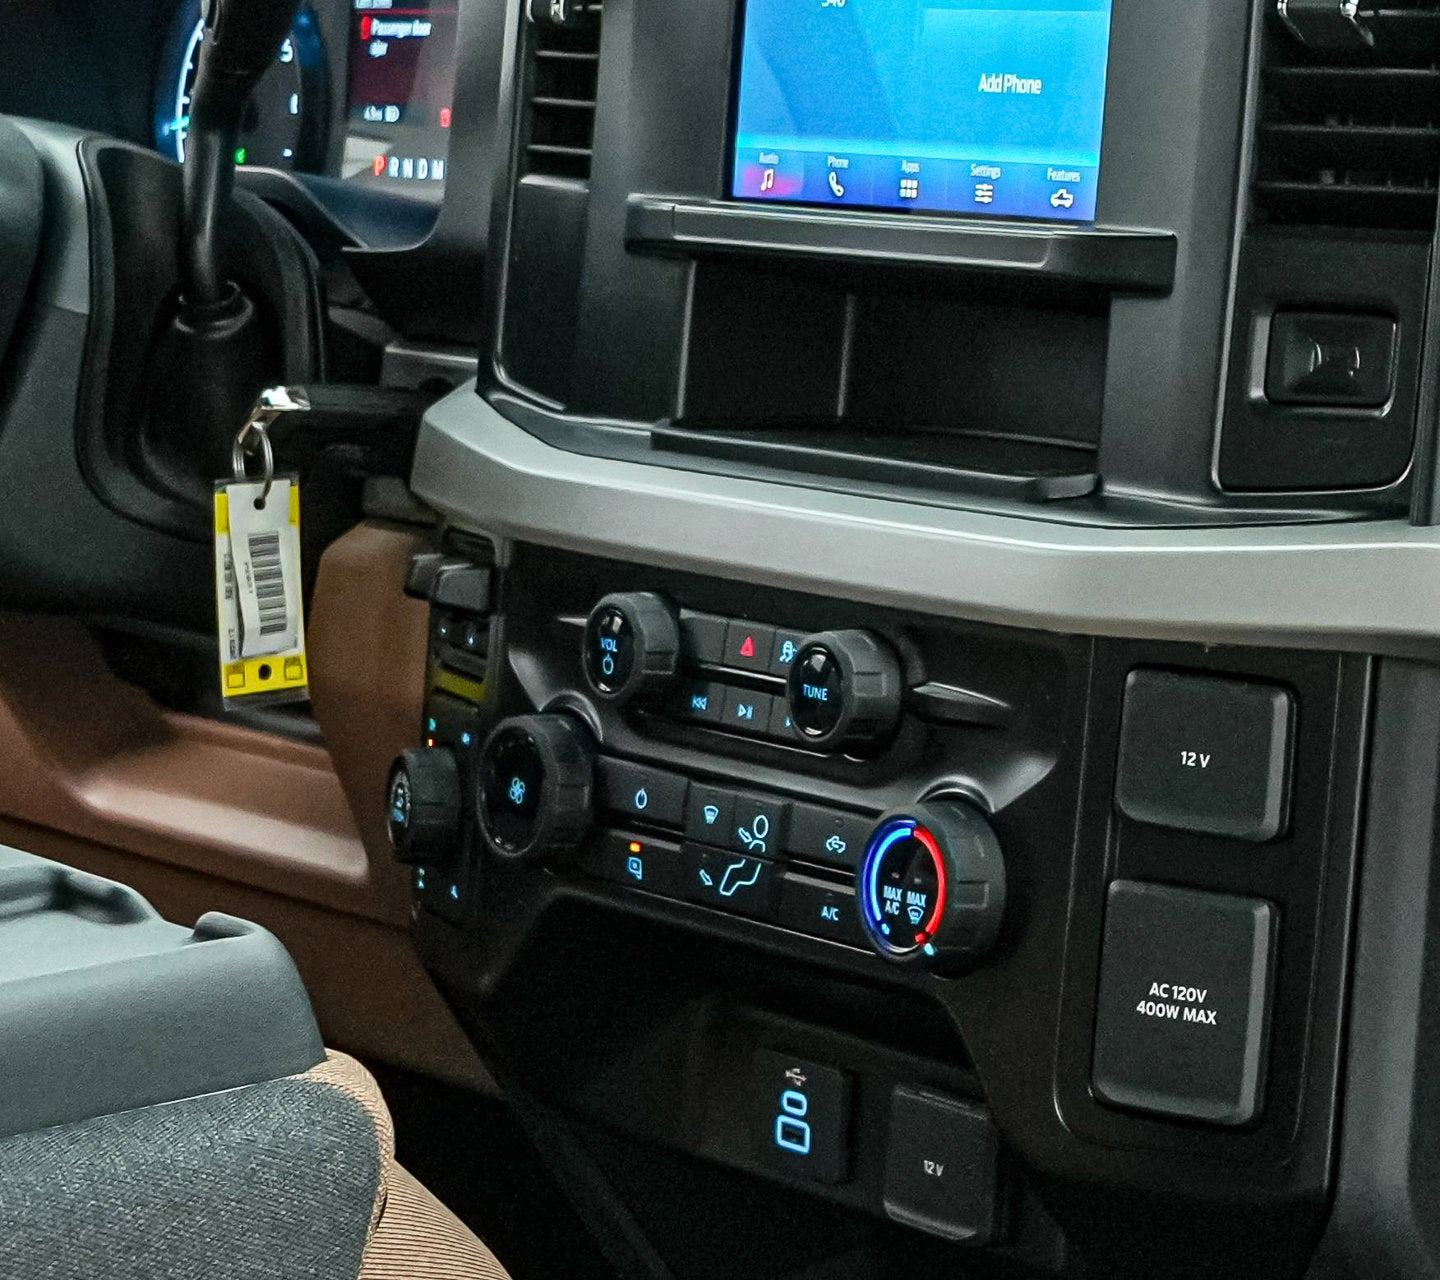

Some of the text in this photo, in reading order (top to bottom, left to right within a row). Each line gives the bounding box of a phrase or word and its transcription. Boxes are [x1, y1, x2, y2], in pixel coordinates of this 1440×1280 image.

[978, 73, 1042, 95] Add Phone
[373, 155, 387, 176] P
[389, 156, 400, 178] R
[402, 158, 413, 179] N
[417, 158, 428, 180] D
[827, 156, 849, 169] Phone
[901, 159, 920, 173] Apps
[970, 163, 1001, 180] Settings
[1046, 167, 1081, 183] Features
[600, 637, 618, 652] VOL
[803, 684, 828, 701] TUNE
[883, 885, 903, 902] MAX
[906, 891, 927, 908] MAX
[821, 906, 839, 921] A/C
[884, 900, 900, 915] A/C
[1149, 982, 1208, 1003] AC 120V
[1136, 1000, 1217, 1025] 400W MAX
